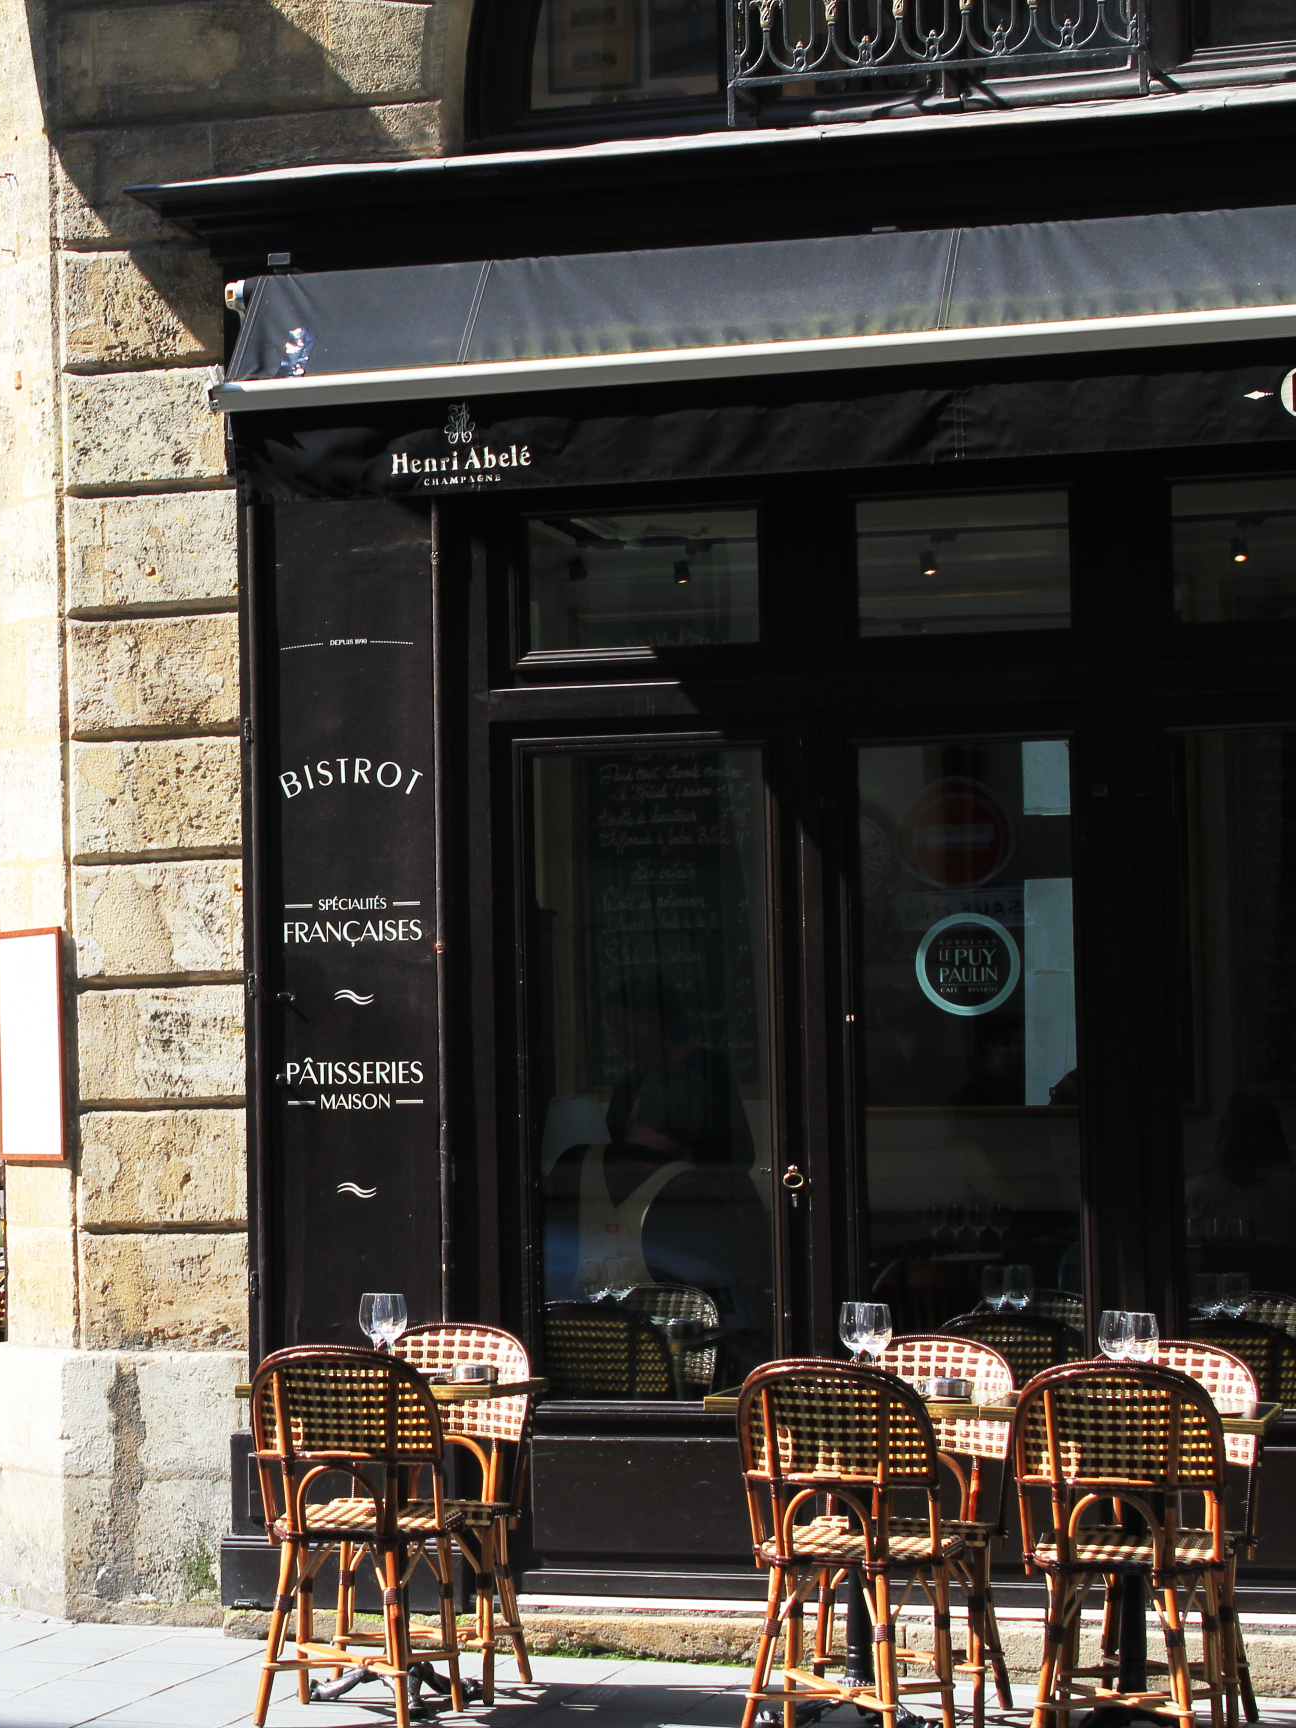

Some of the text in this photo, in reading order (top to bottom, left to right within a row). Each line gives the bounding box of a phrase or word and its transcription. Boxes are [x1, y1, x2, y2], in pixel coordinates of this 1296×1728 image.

[391, 444, 532, 475] Henri Abelé
[424, 474, 501, 486] CHAMPAGNE
[279, 757, 423, 799] BISTROT
[318, 895, 387, 911] SPÉCIALITÉS
[283, 919, 423, 948] FRANÇAISES
[939, 948, 997, 966] LE PUY
[940, 967, 998, 983] PAULIN
[286, 1057, 424, 1085] PÂTISSERIES
[320, 1093, 391, 1110] MAISON
